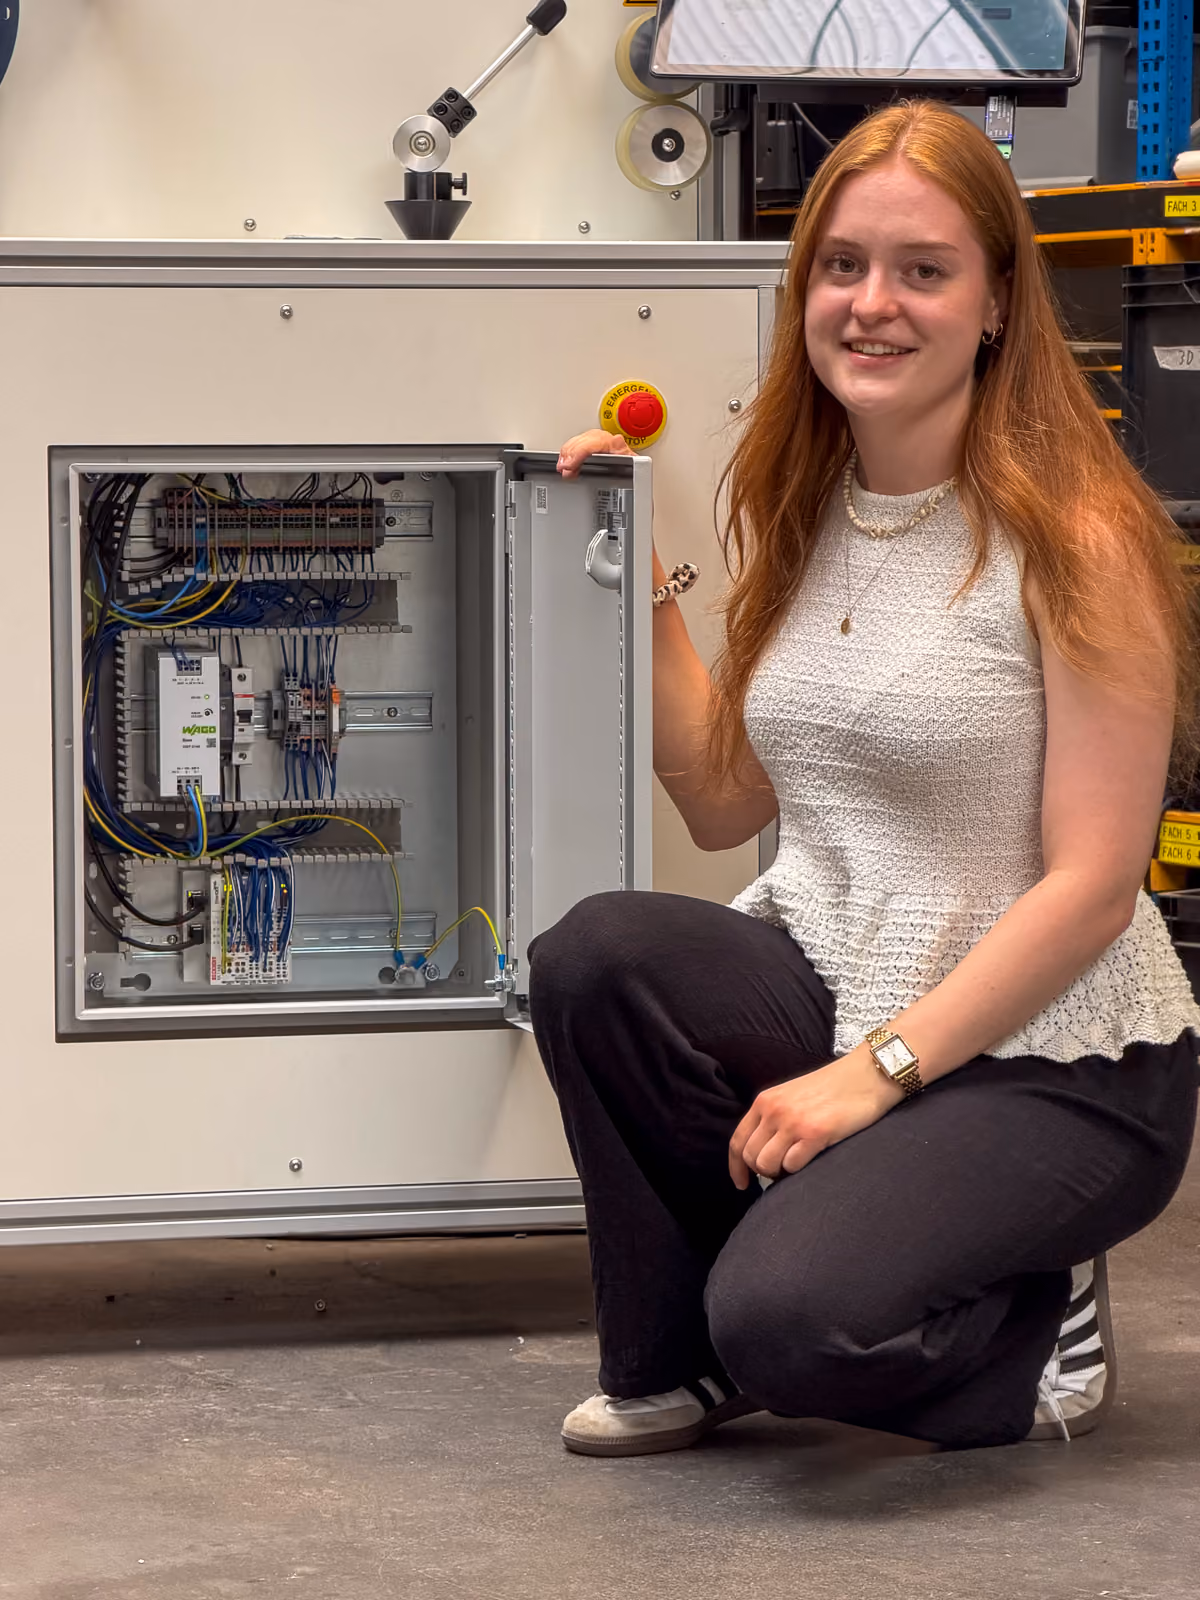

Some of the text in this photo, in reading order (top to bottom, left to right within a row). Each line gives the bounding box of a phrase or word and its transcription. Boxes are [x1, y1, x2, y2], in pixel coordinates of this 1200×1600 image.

[1167, 200, 1197, 213] FACH 3
[1179, 350, 1194, 365] 3D
[606, 384, 650, 408] EMERGE
[623, 436, 647, 446] TOP
[182, 724, 217, 736] WAGO
[1162, 826, 1192, 840] FACH 5
[1162, 845, 1192, 861] FACH 6
